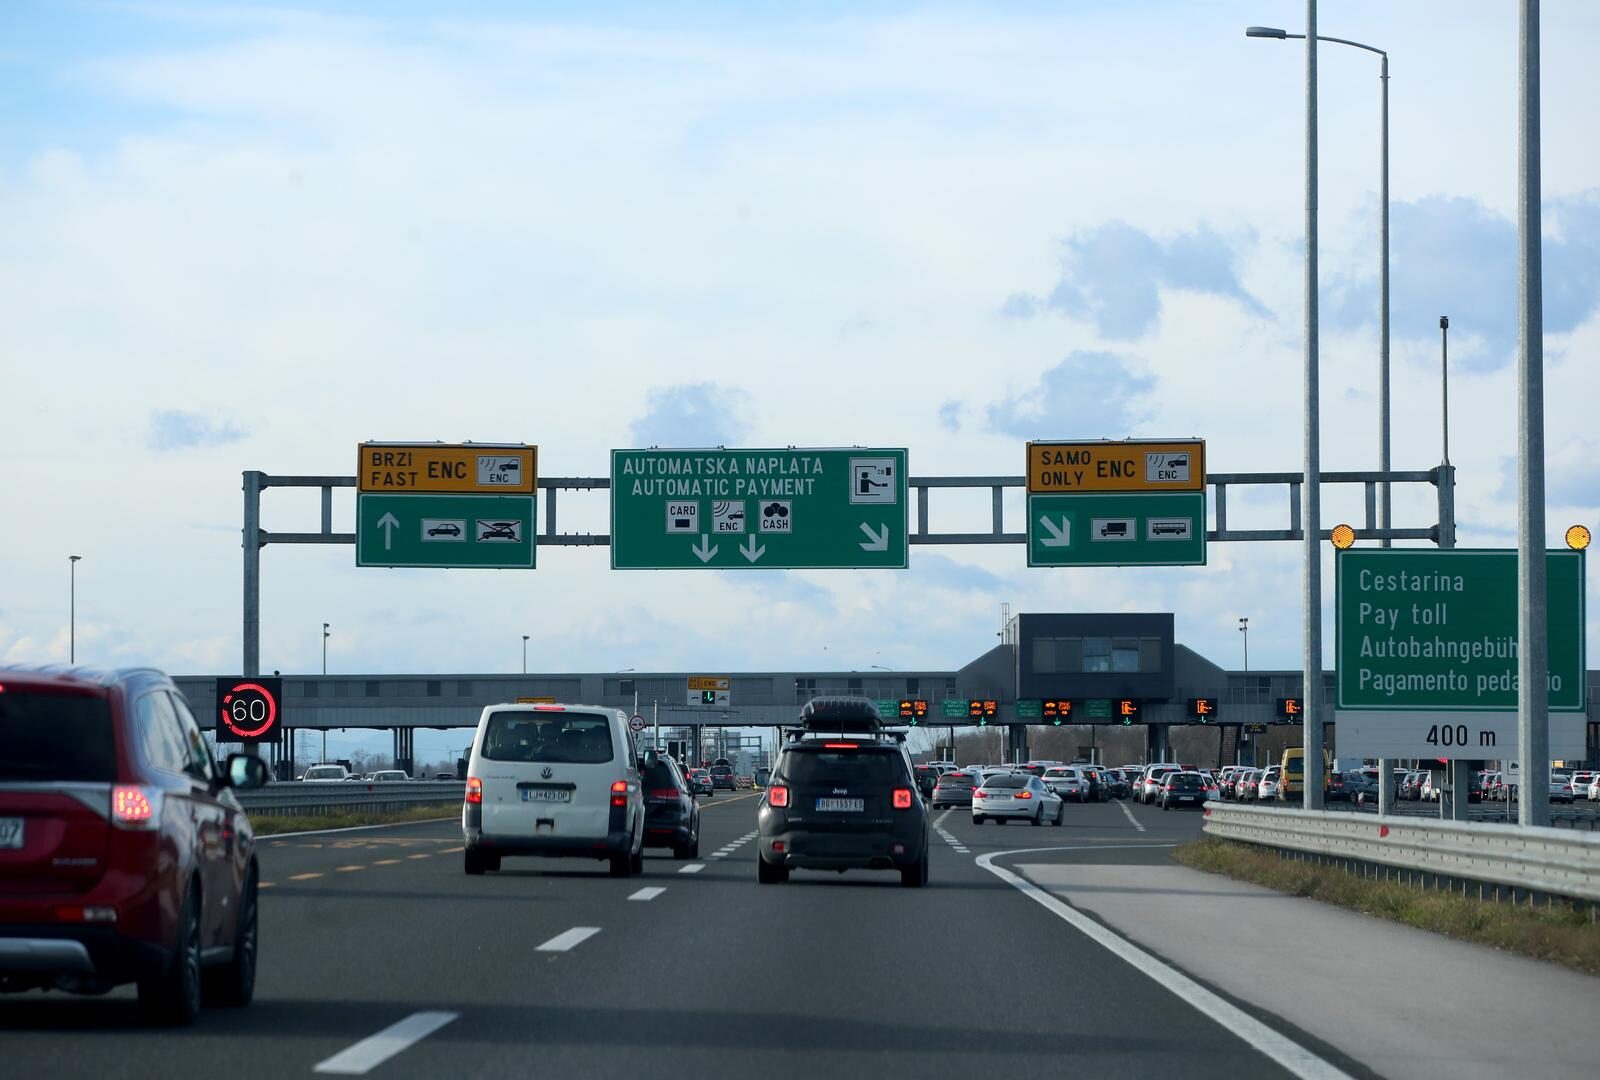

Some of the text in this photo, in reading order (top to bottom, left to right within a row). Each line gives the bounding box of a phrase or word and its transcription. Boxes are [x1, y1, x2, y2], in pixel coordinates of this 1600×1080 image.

[372, 452, 412, 467] BRZI
[1041, 450, 1091, 465] SAMO
[428, 461, 467, 479] ENC
[623, 457, 824, 475] AUTOMATSKA NAPLATA
[1097, 460, 1136, 478] ENC
[371, 472, 418, 486] FAST
[489, 474, 509, 483] ENC
[1041, 471, 1084, 486] ONLY
[1158, 470, 1177, 479] ENC
[632, 478, 816, 496] AUTOMATIC PAYMENT
[670, 506, 696, 516] CARD
[719, 522, 738, 531] ENC
[763, 519, 789, 529] CASH
[1359, 569, 1464, 591] Cestarina
[1359, 603, 1447, 631] Pay toll
[1359, 668, 1562, 697] Pagamento pedaio
[232, 699, 266, 721] 60
[1426, 724, 1496, 746] 400 m
[832, 787, 848, 795] Jeep
